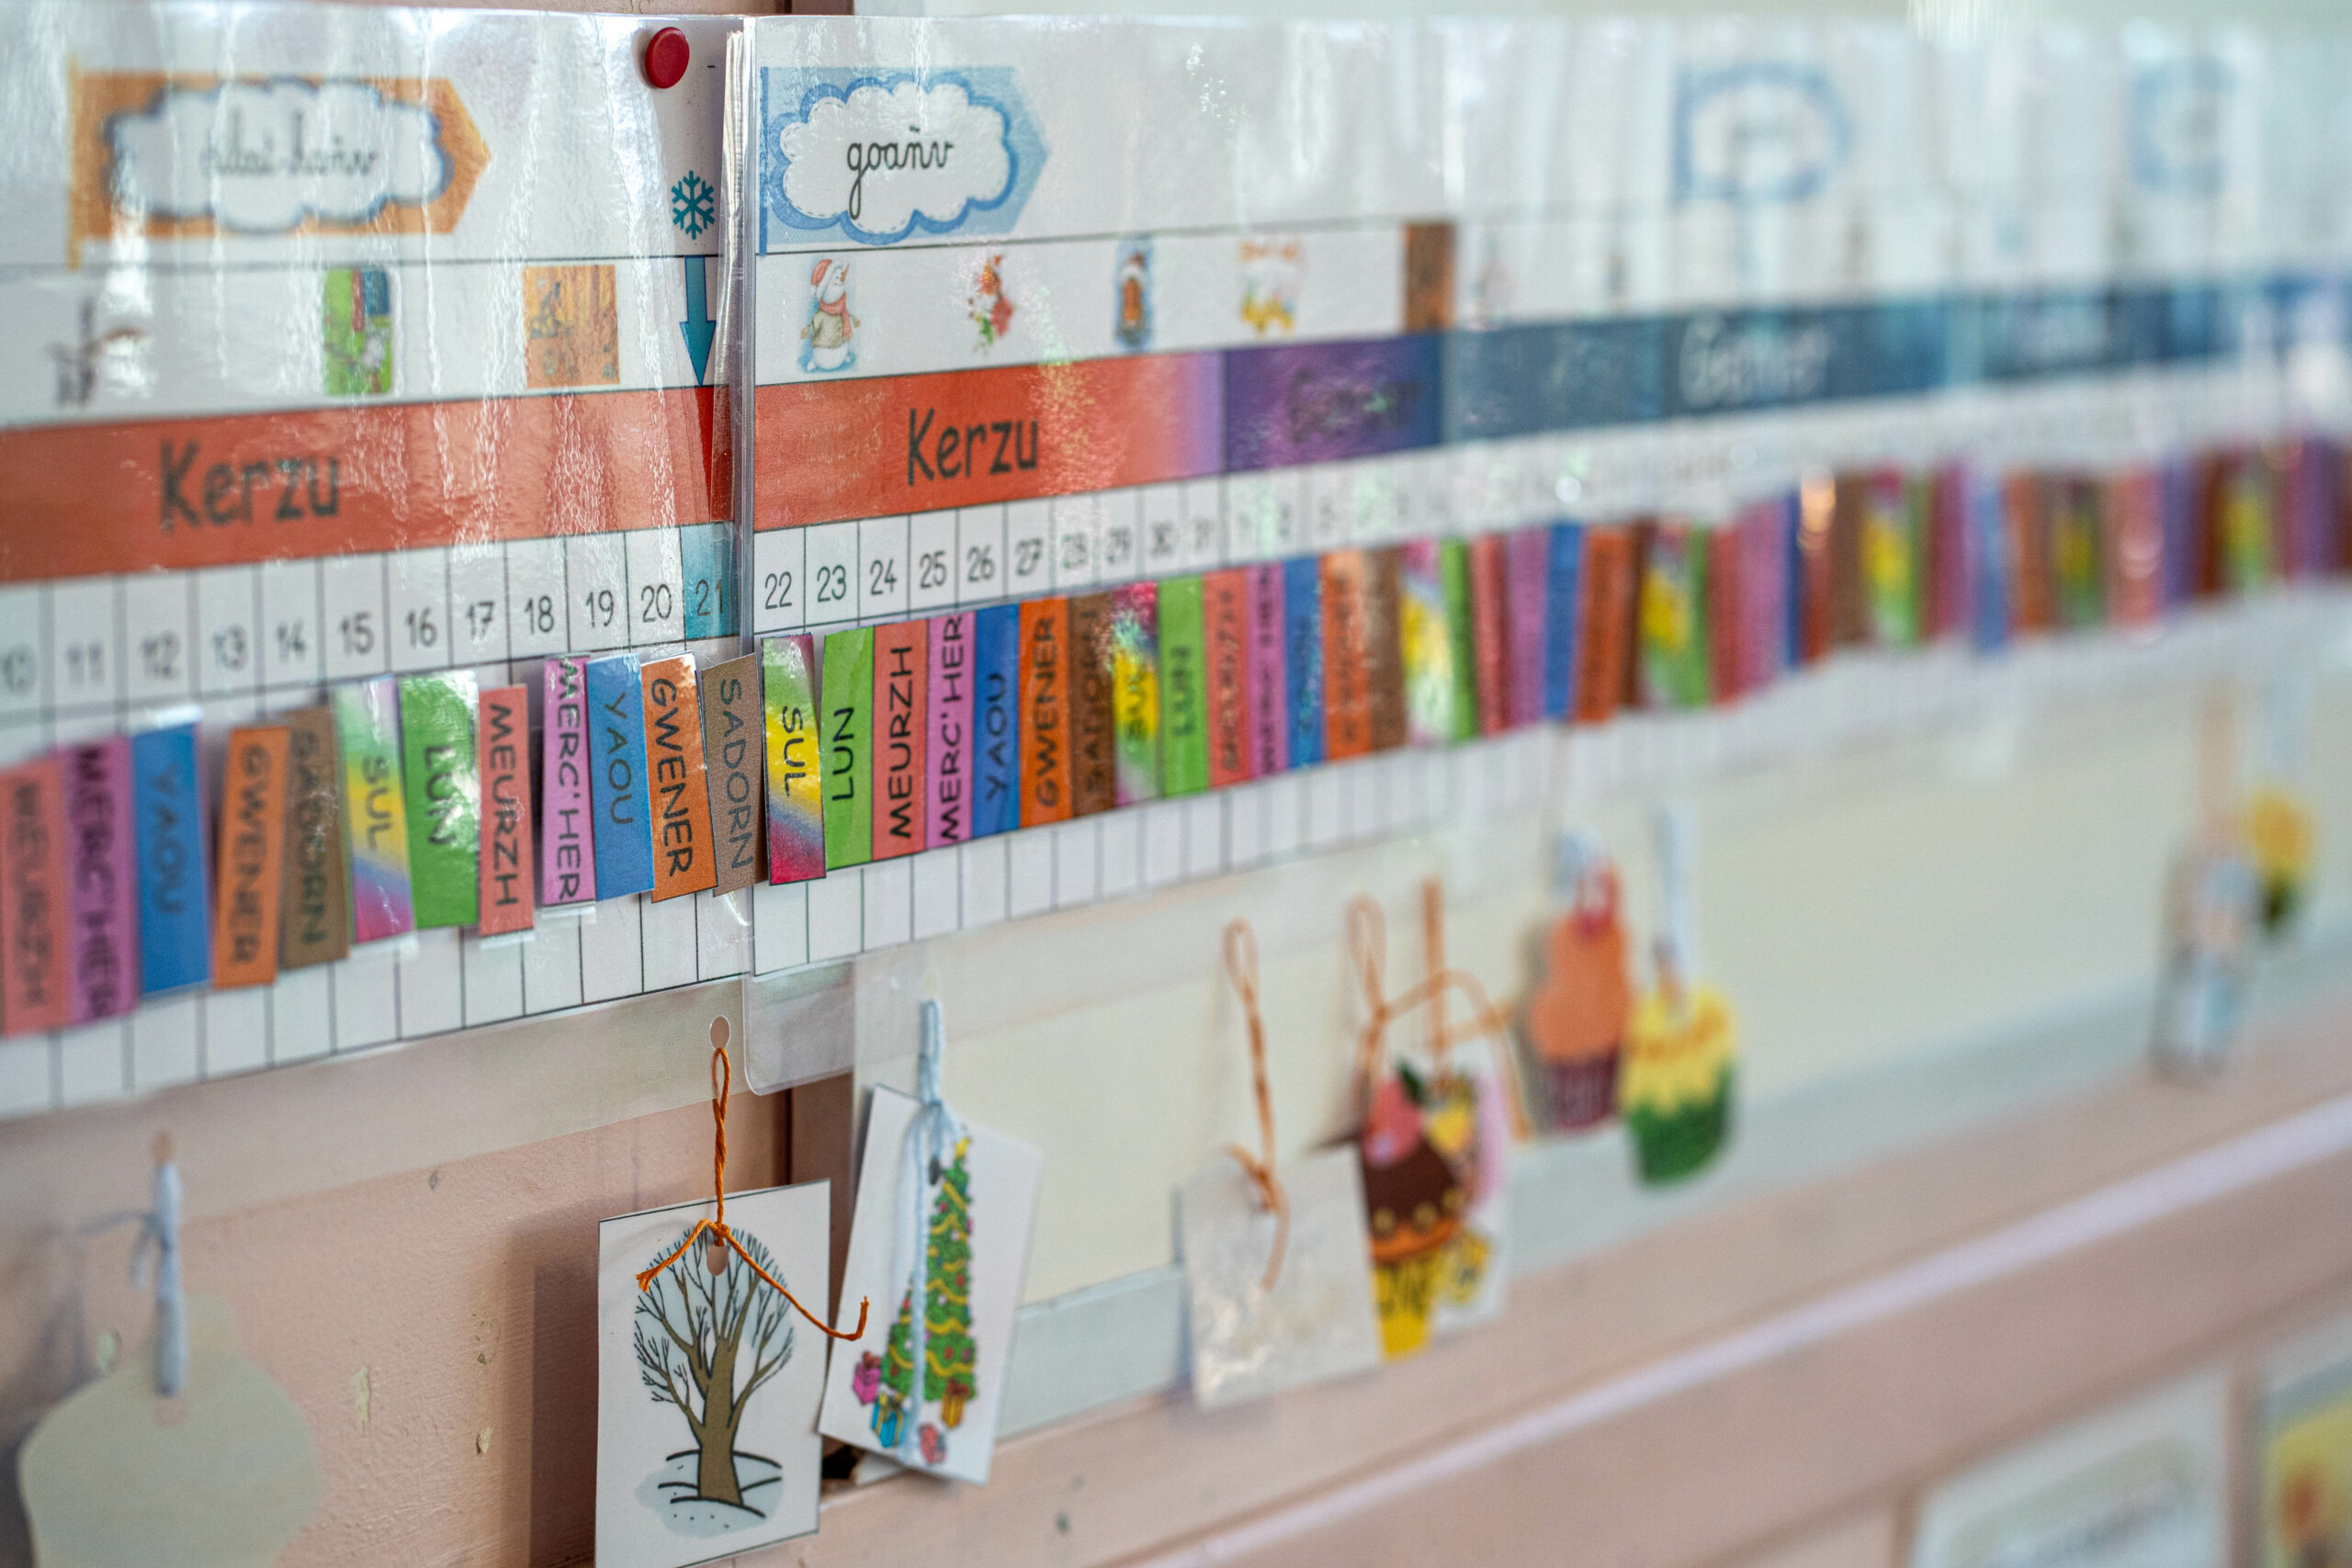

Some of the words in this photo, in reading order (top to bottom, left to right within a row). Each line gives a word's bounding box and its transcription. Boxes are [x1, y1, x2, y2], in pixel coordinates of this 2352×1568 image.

[847, 126, 955, 220] goañv
[159, 439, 340, 536] Kerzu
[908, 407, 1039, 487] Kerzu
[277, 619, 309, 664] 14
[337, 610, 375, 656] 15
[404, 606, 438, 648] 16
[465, 601, 495, 641] 17
[524, 595, 555, 635] 18
[584, 589, 615, 629] 19
[640, 582, 673, 623] 20
[694, 579, 726, 617] 21
[764, 570, 793, 611] 22
[816, 563, 847, 603] 23
[869, 558, 898, 596] 24
[919, 550, 947, 589] 25
[966, 545, 995, 583] 26
[1014, 536, 1043, 578] 27
[604, 691, 634, 825] YAOU
[650, 677, 694, 878] GWENER
[719, 677, 754, 870] SADORN
[782, 705, 806, 797] SUL
[831, 706, 854, 801] LUN
[888, 646, 913, 839] MEURZH
[940, 615, 964, 840] MERC'HER
[985, 672, 1009, 803] YAOU
[1033, 615, 1060, 808] GWENER
[150, 761, 187, 916] YAOU
[362, 754, 393, 851] SUL
[424, 743, 459, 845] LUN
[489, 702, 519, 908] MEURZH
[557, 655, 582, 901] MERC'HER
[231, 741, 272, 964] GWENER
